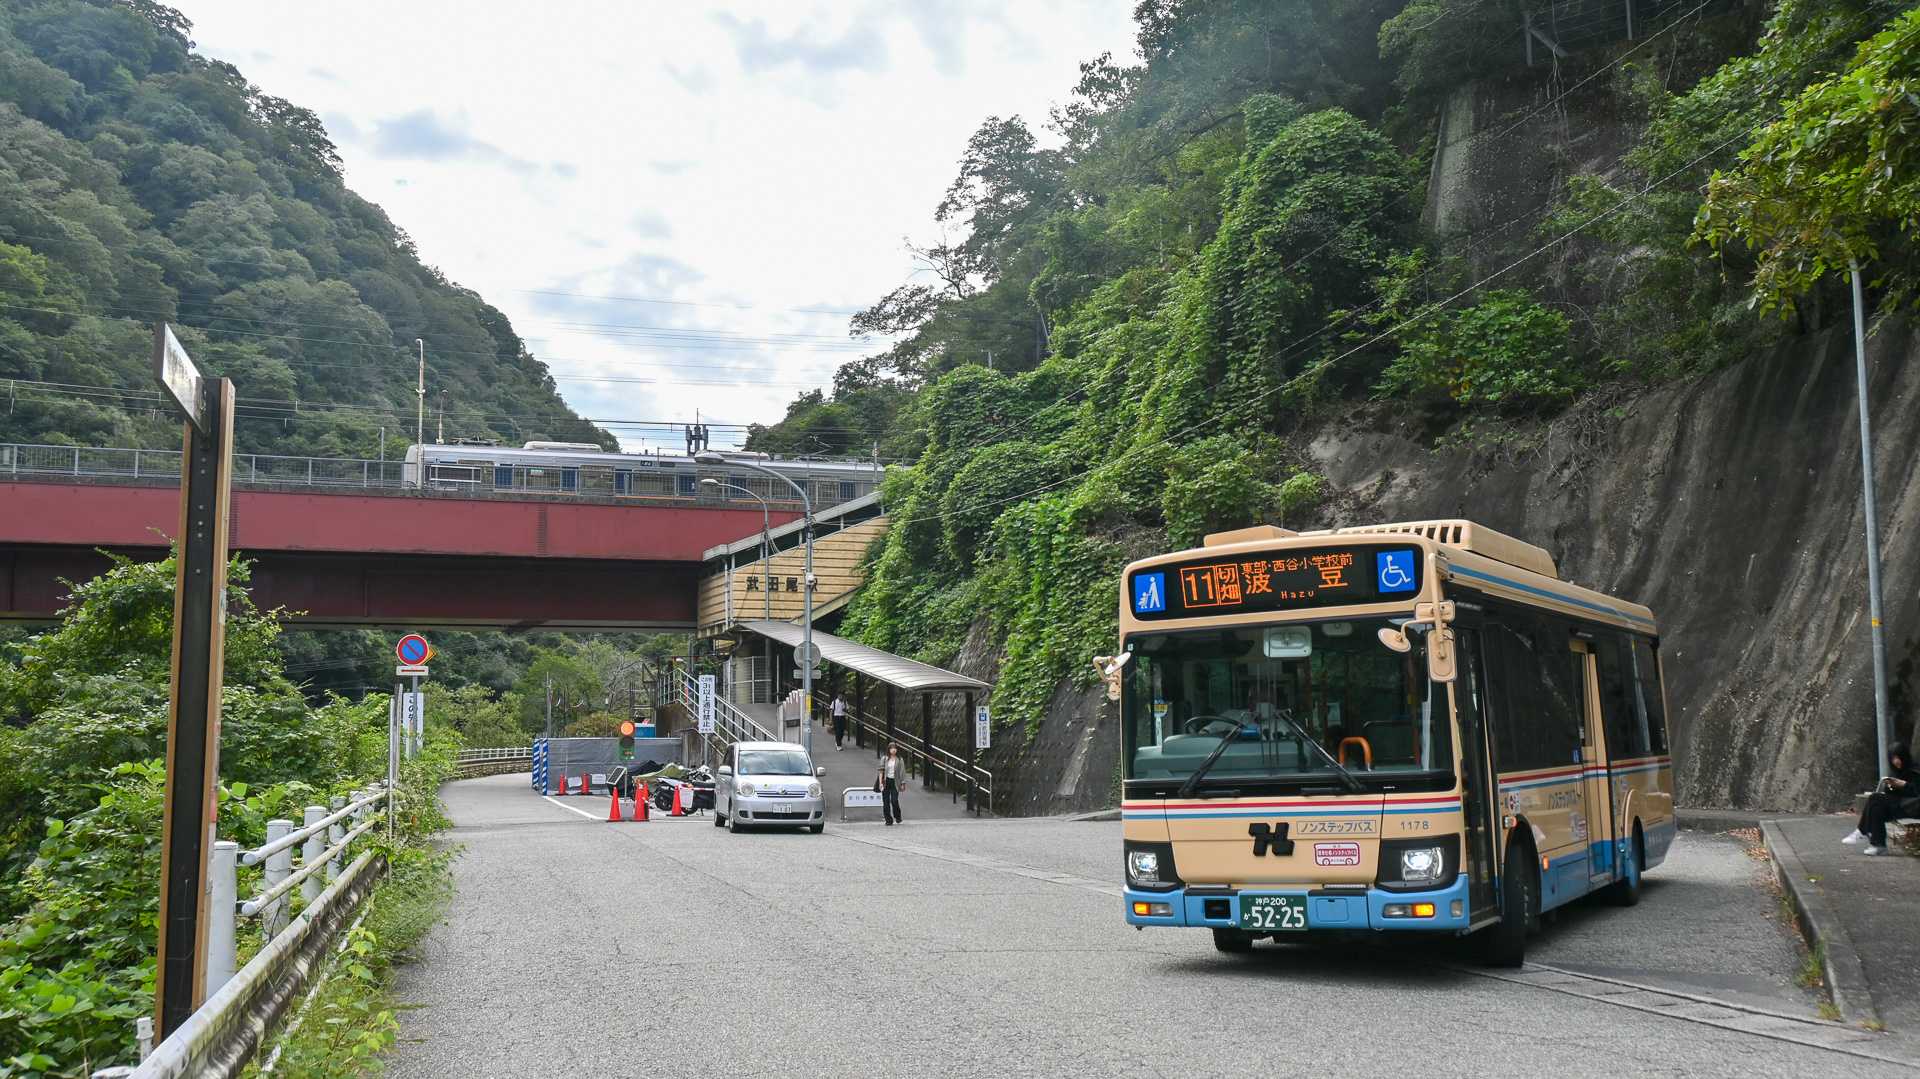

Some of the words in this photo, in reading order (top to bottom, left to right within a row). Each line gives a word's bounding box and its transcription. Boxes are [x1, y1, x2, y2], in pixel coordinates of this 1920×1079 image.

[1241, 553, 1353, 576] 東部・西谷小学校前
[1185, 572, 1214, 601] 11
[1300, 821, 1373, 833] ノンステップバス
[1401, 820, 1429, 831] 1178
[1251, 906, 1305, 928] 52-25
